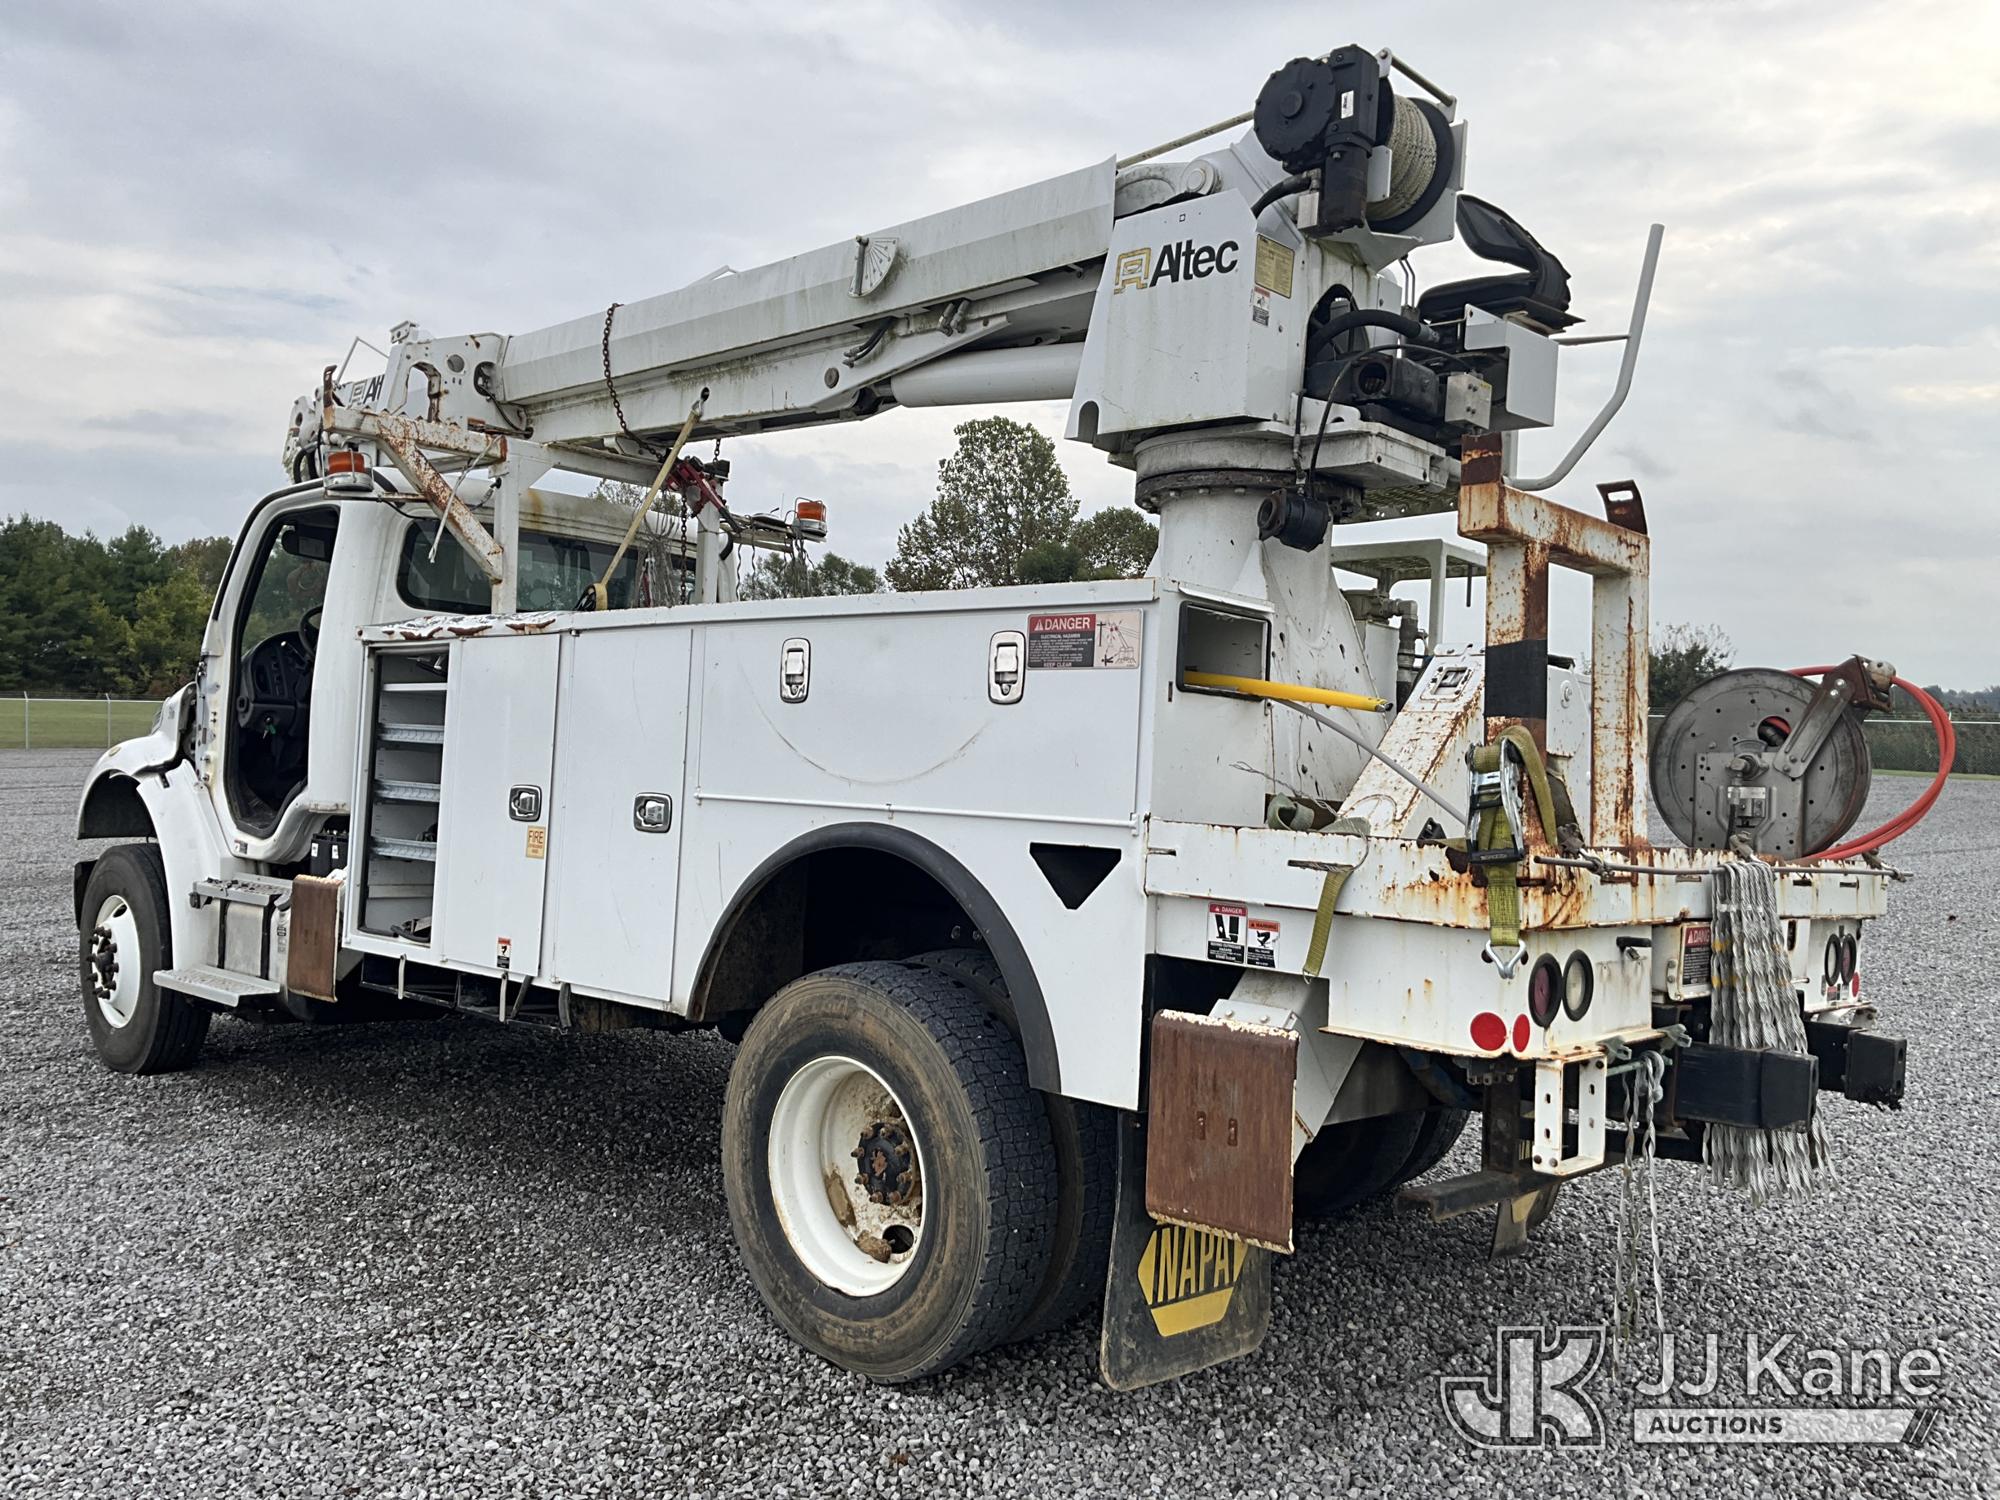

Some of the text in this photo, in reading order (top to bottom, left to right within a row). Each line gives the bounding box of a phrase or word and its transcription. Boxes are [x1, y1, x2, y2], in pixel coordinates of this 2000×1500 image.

[1150, 240, 1239, 288] Altec
[1044, 617, 1091, 631] DANGER
[528, 830, 544, 844] FIRE
[1221, 906, 1243, 914] DANGER
[1157, 1226, 1230, 1303] NAPA
